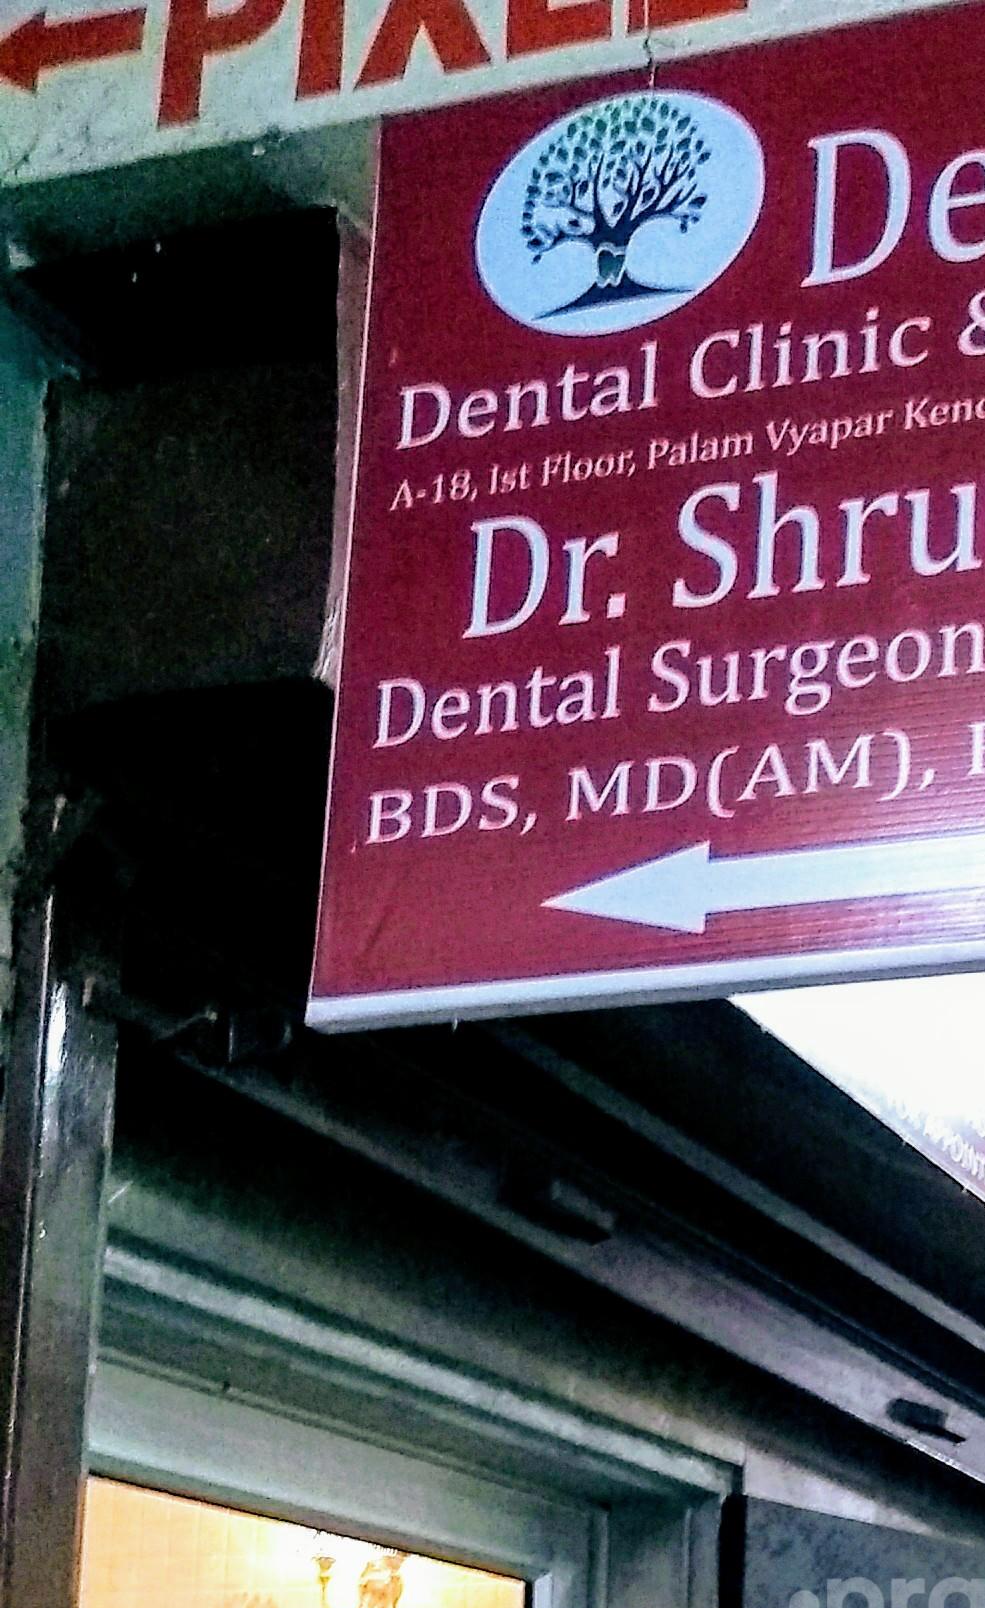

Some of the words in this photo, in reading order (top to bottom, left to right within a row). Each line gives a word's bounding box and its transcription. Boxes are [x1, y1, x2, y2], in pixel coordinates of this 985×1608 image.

[396, 340, 661, 451] Dental
[689, 304, 931, 401] Clinic
[389, 467, 479, 512] A-18,
[541, 444, 638, 484] Floor,
[648, 428, 753, 473] Palam
[764, 406, 894, 459] Vyapar
[462, 514, 627, 640] Dr.
[372, 647, 620, 751] Dental
[364, 776, 538, 846] BDS,
[564, 729, 935, 821] MD(AM),
